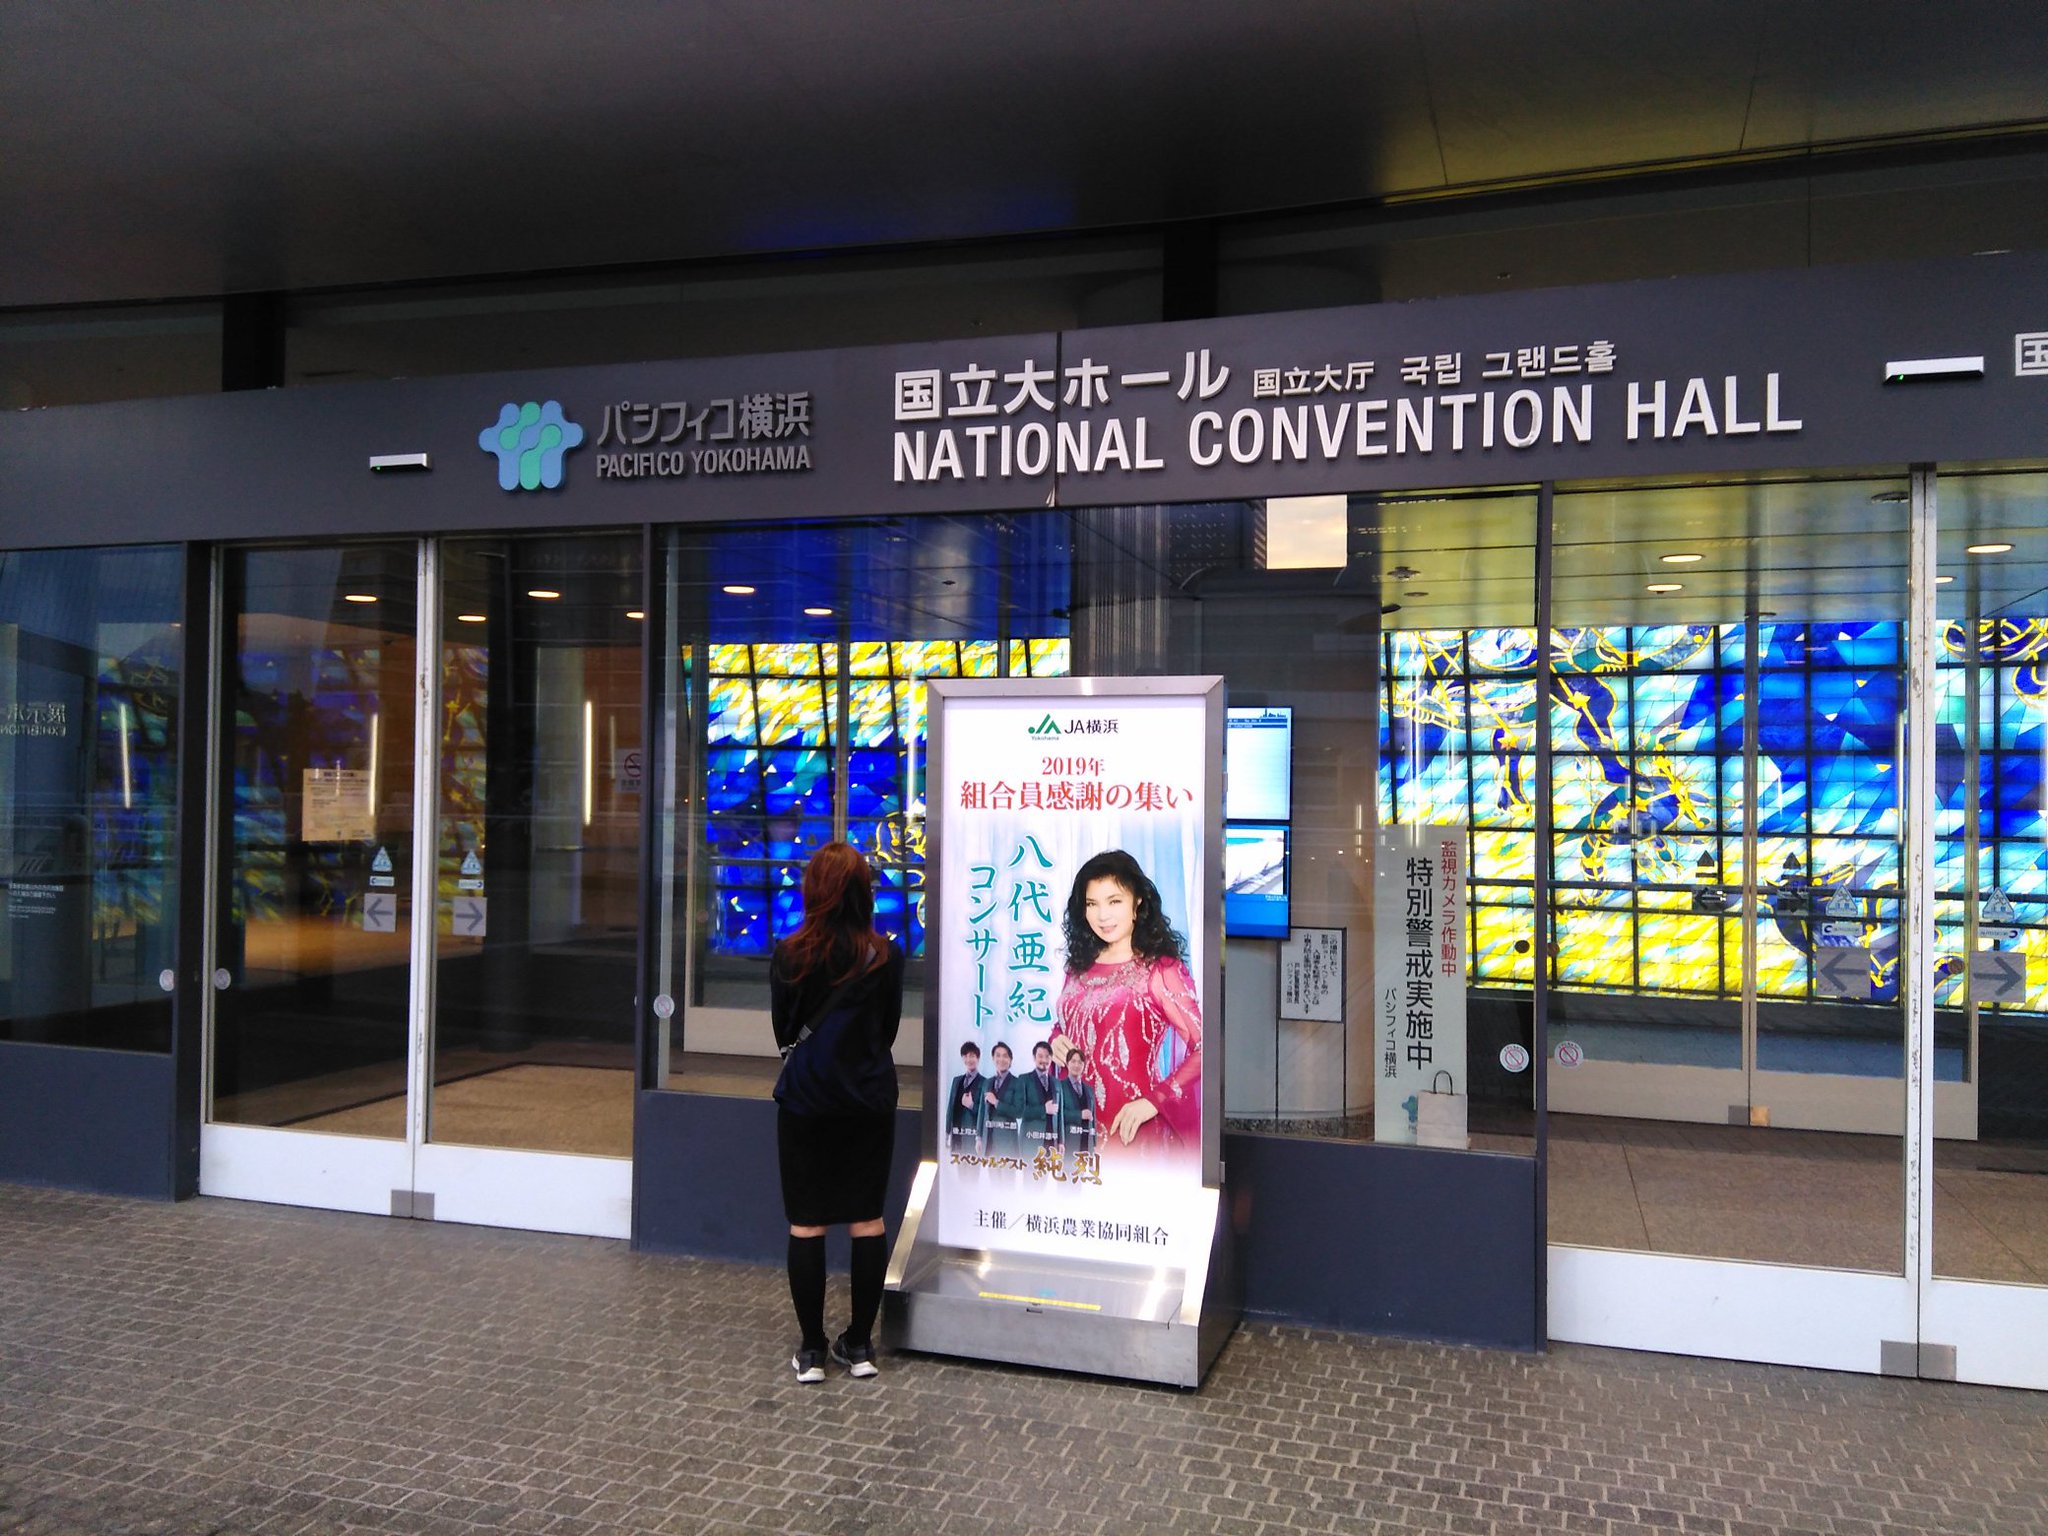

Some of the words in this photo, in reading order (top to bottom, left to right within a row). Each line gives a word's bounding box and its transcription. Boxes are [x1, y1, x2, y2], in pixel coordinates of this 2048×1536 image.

[895, 349, 1231, 421] 国立大ホール
[1252, 361, 1376, 399] 国立大厅
[1400, 352, 1464, 388] 국립
[1482, 340, 1617, 380] 그랜드홀
[597, 391, 811, 446] パシフィコ横浜
[892, 418, 1164, 483] NATIONAL
[1189, 384, 1594, 465] CONVENTION
[1626, 371, 1804, 441] HALL
[596, 452, 684, 478] PACIFICO
[692, 445, 812, 474] YOKOHAMA
[1064, 718, 1119, 735] JA横浜
[960, 780, 1193, 811] 組合員感謝の集い
[1042, 757, 1105, 777] 2019年
[1007, 835, 1053, 1023] 八代亜紀
[1441, 841, 1457, 978] 監視カメラ作動中
[966, 866, 998, 1027] コンサート
[1406, 857, 1433, 1070] 特別警戒実施中
[1384, 988, 1397, 1078] パシフィコ横浜
